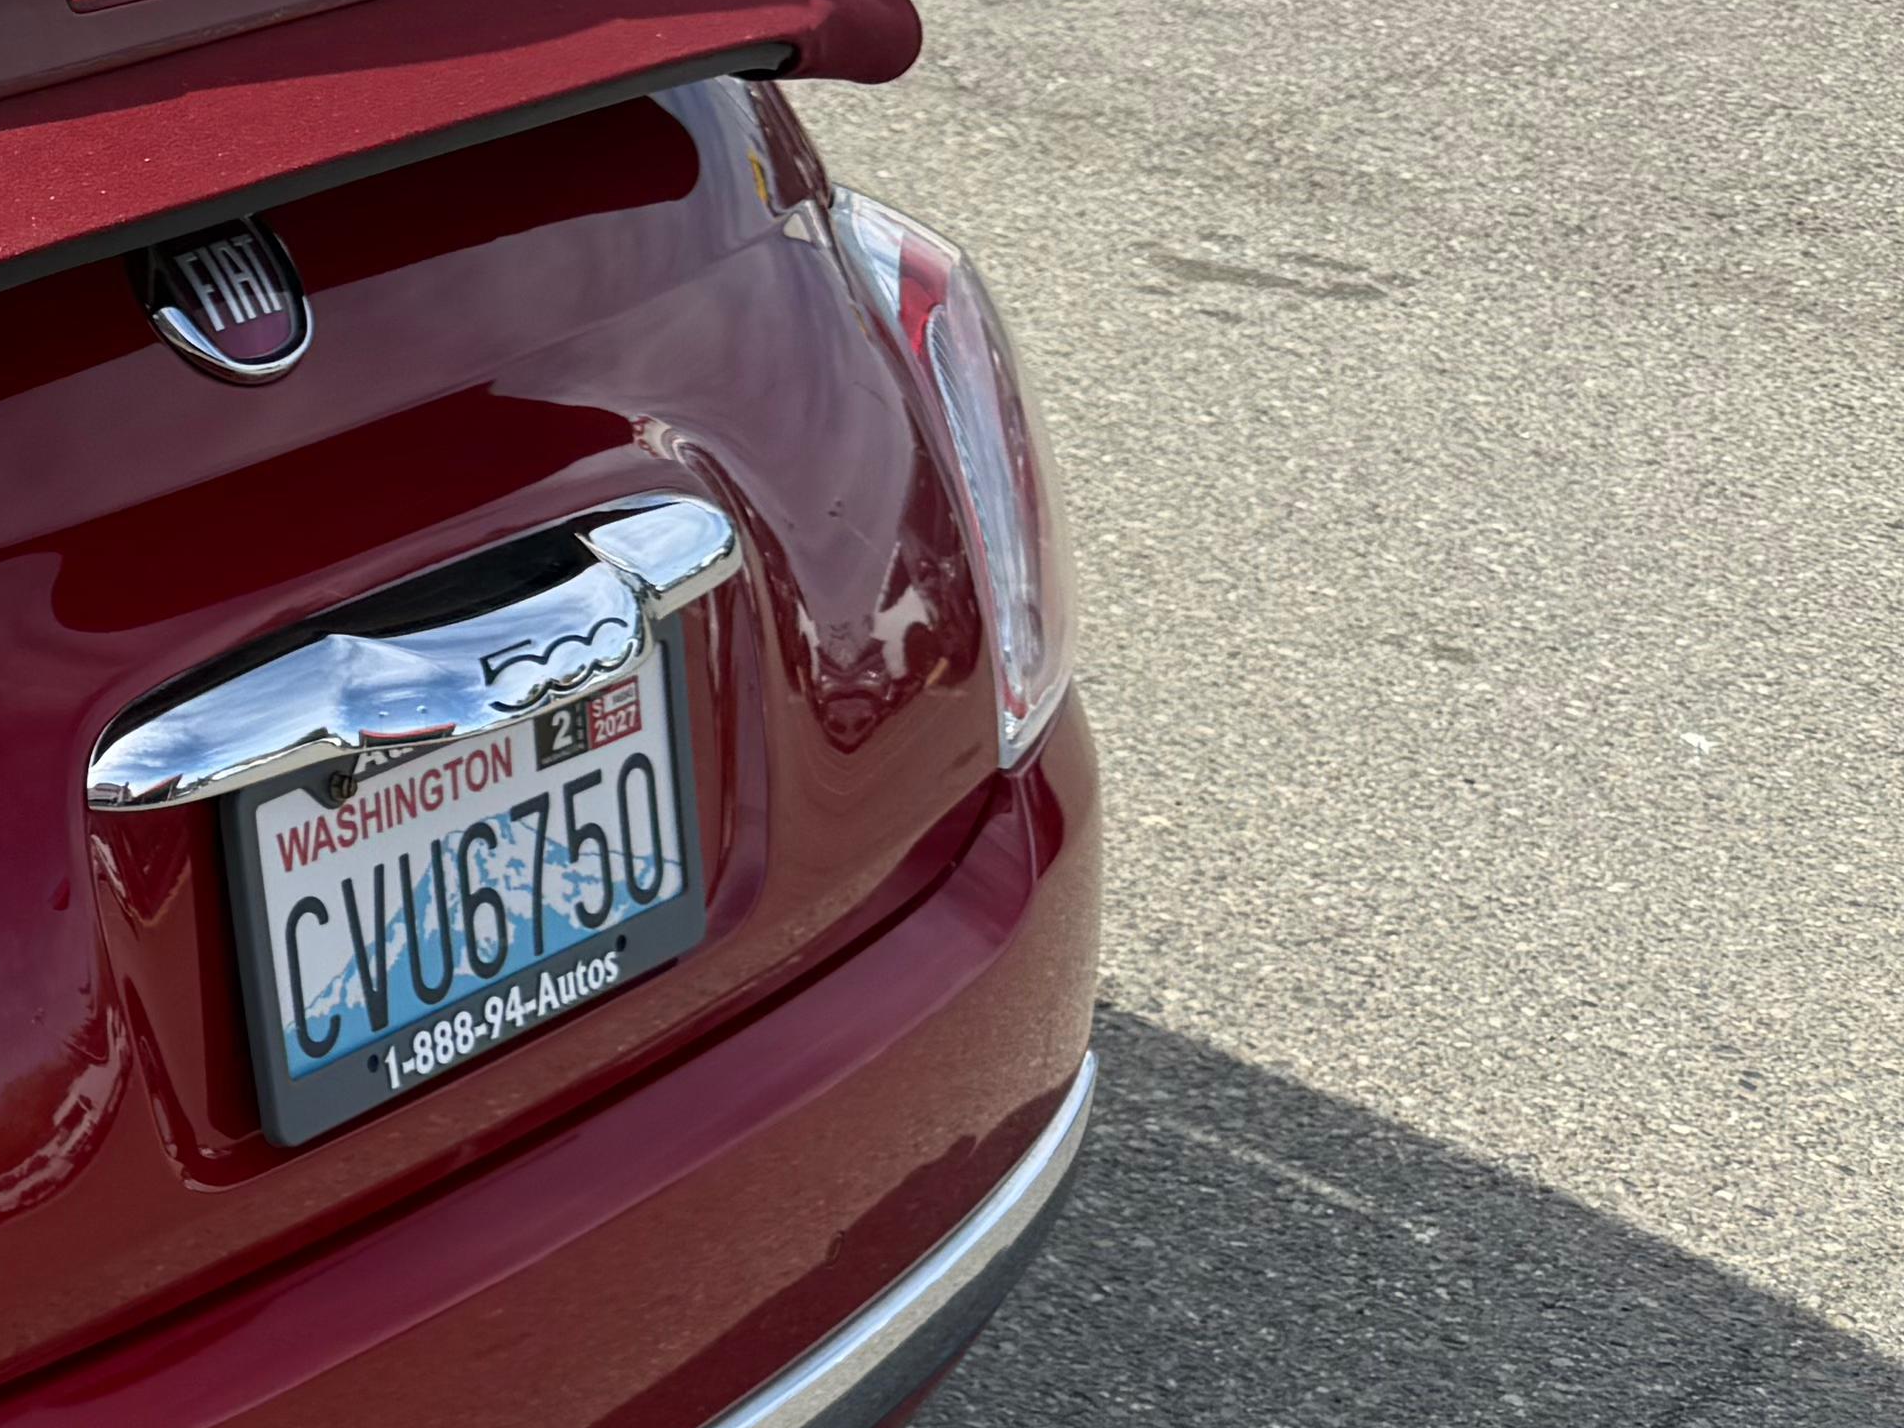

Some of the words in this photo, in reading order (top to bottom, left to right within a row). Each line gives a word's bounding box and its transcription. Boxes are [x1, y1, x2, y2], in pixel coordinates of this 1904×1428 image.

[174, 234, 284, 332] FIAT
[479, 616, 634, 713] 500
[551, 709, 573, 751] 2
[594, 703, 636, 743] 2027
[276, 737, 514, 872] WASHINGTON
[284, 752, 665, 1059] CVU6750
[383, 950, 620, 1090] 1-888-94-Autos
